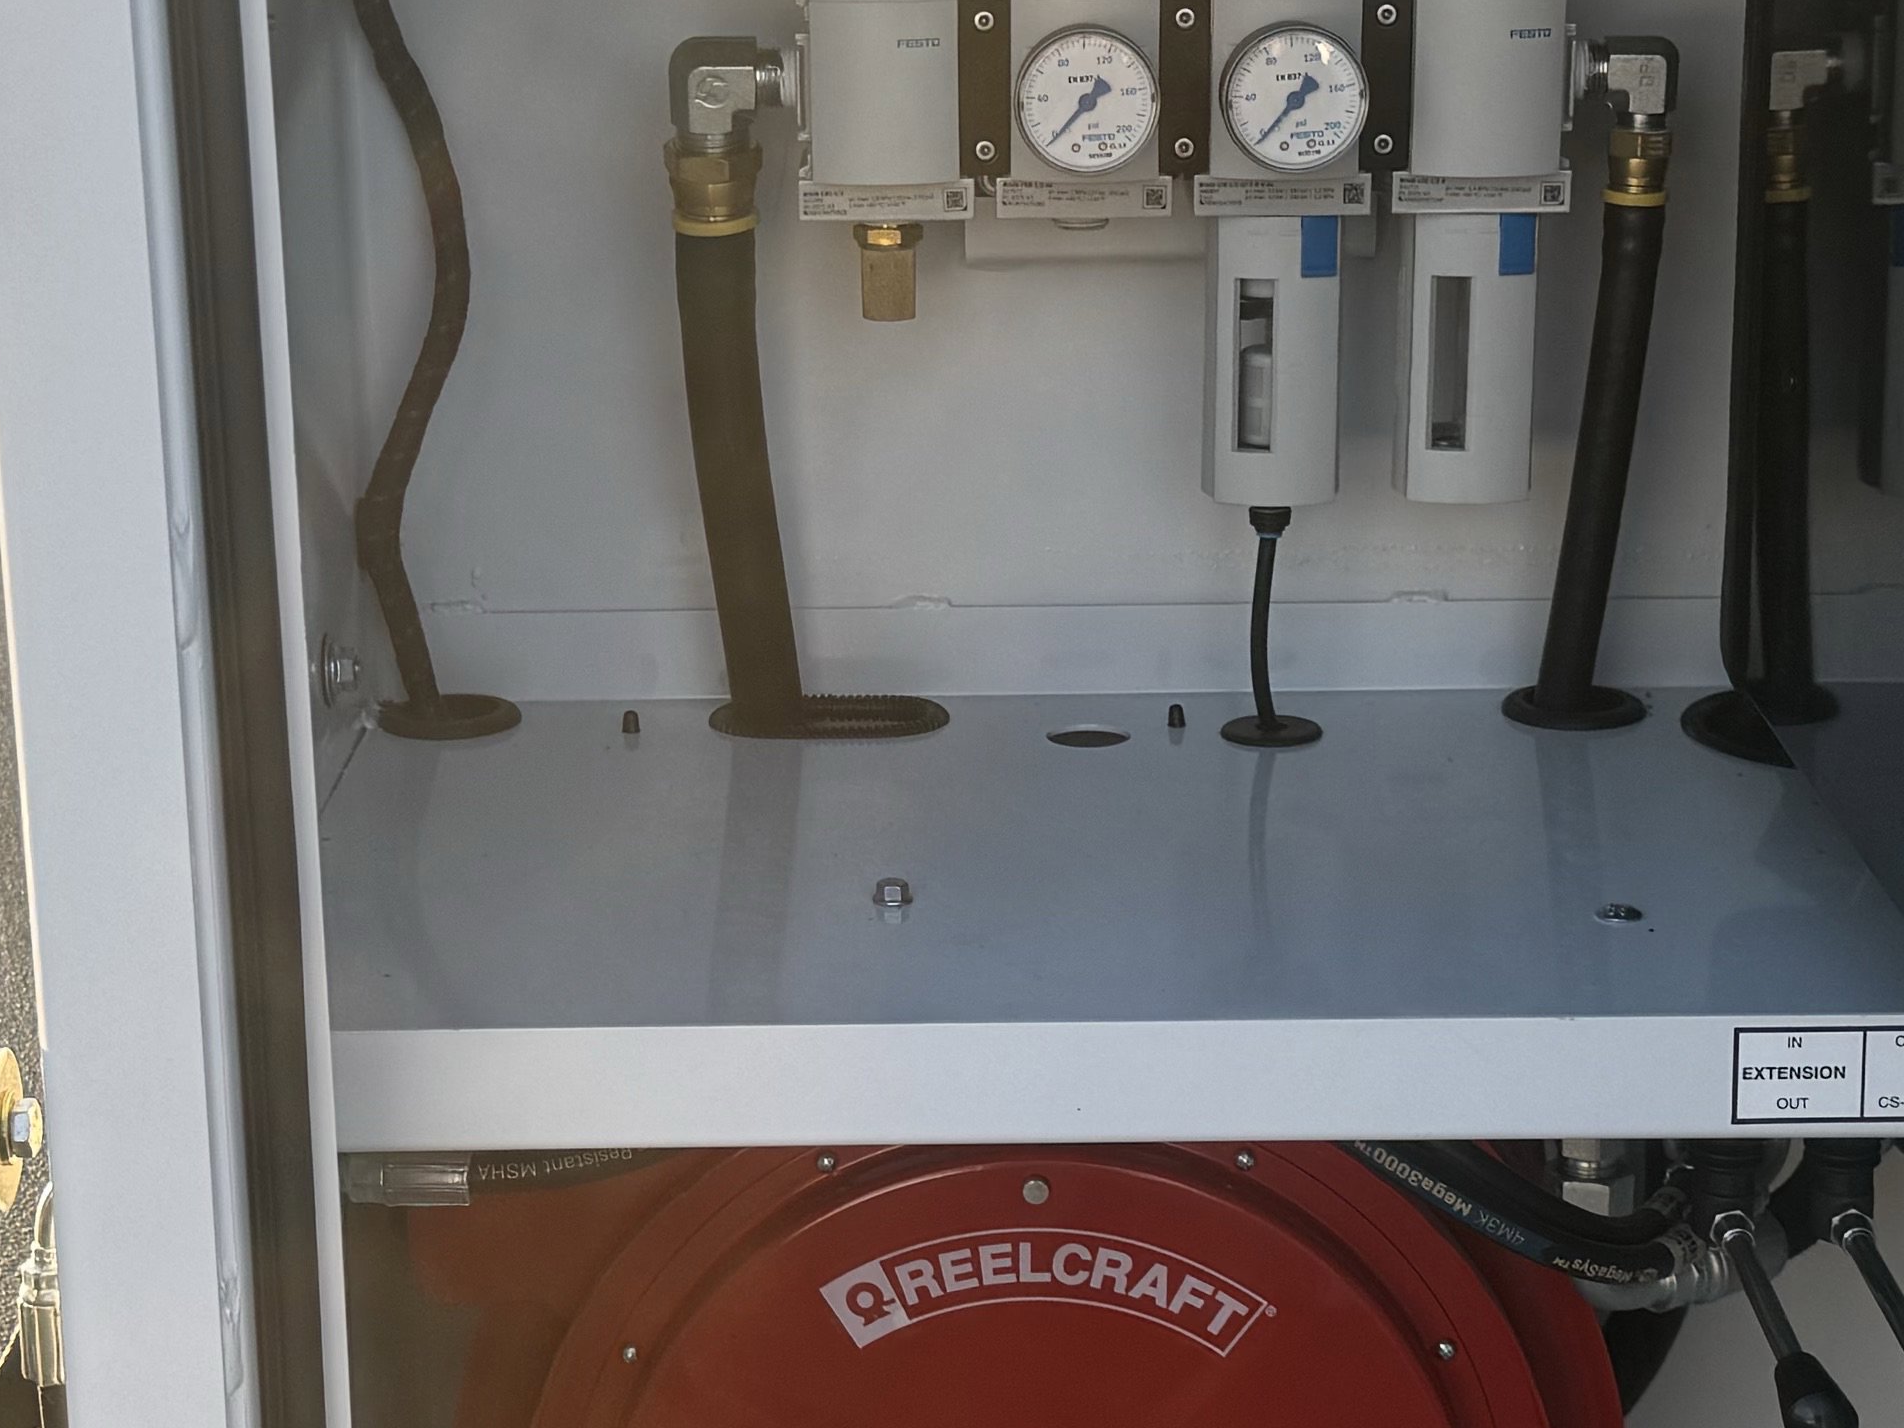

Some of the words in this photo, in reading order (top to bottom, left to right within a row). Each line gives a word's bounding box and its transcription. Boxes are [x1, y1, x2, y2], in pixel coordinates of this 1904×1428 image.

[1510, 28, 1551, 39] FESTO
[897, 38, 940, 48] FESTO
[1324, 122, 1341, 130] 200
[1787, 1035, 1803, 1049] IN
[1742, 1066, 1847, 1081] EXTENSION
[1776, 1097, 1809, 1110] OUT
[478, 1161, 536, 1180] MSHA
[894, 1242, 1249, 1336] REELCRAFT
